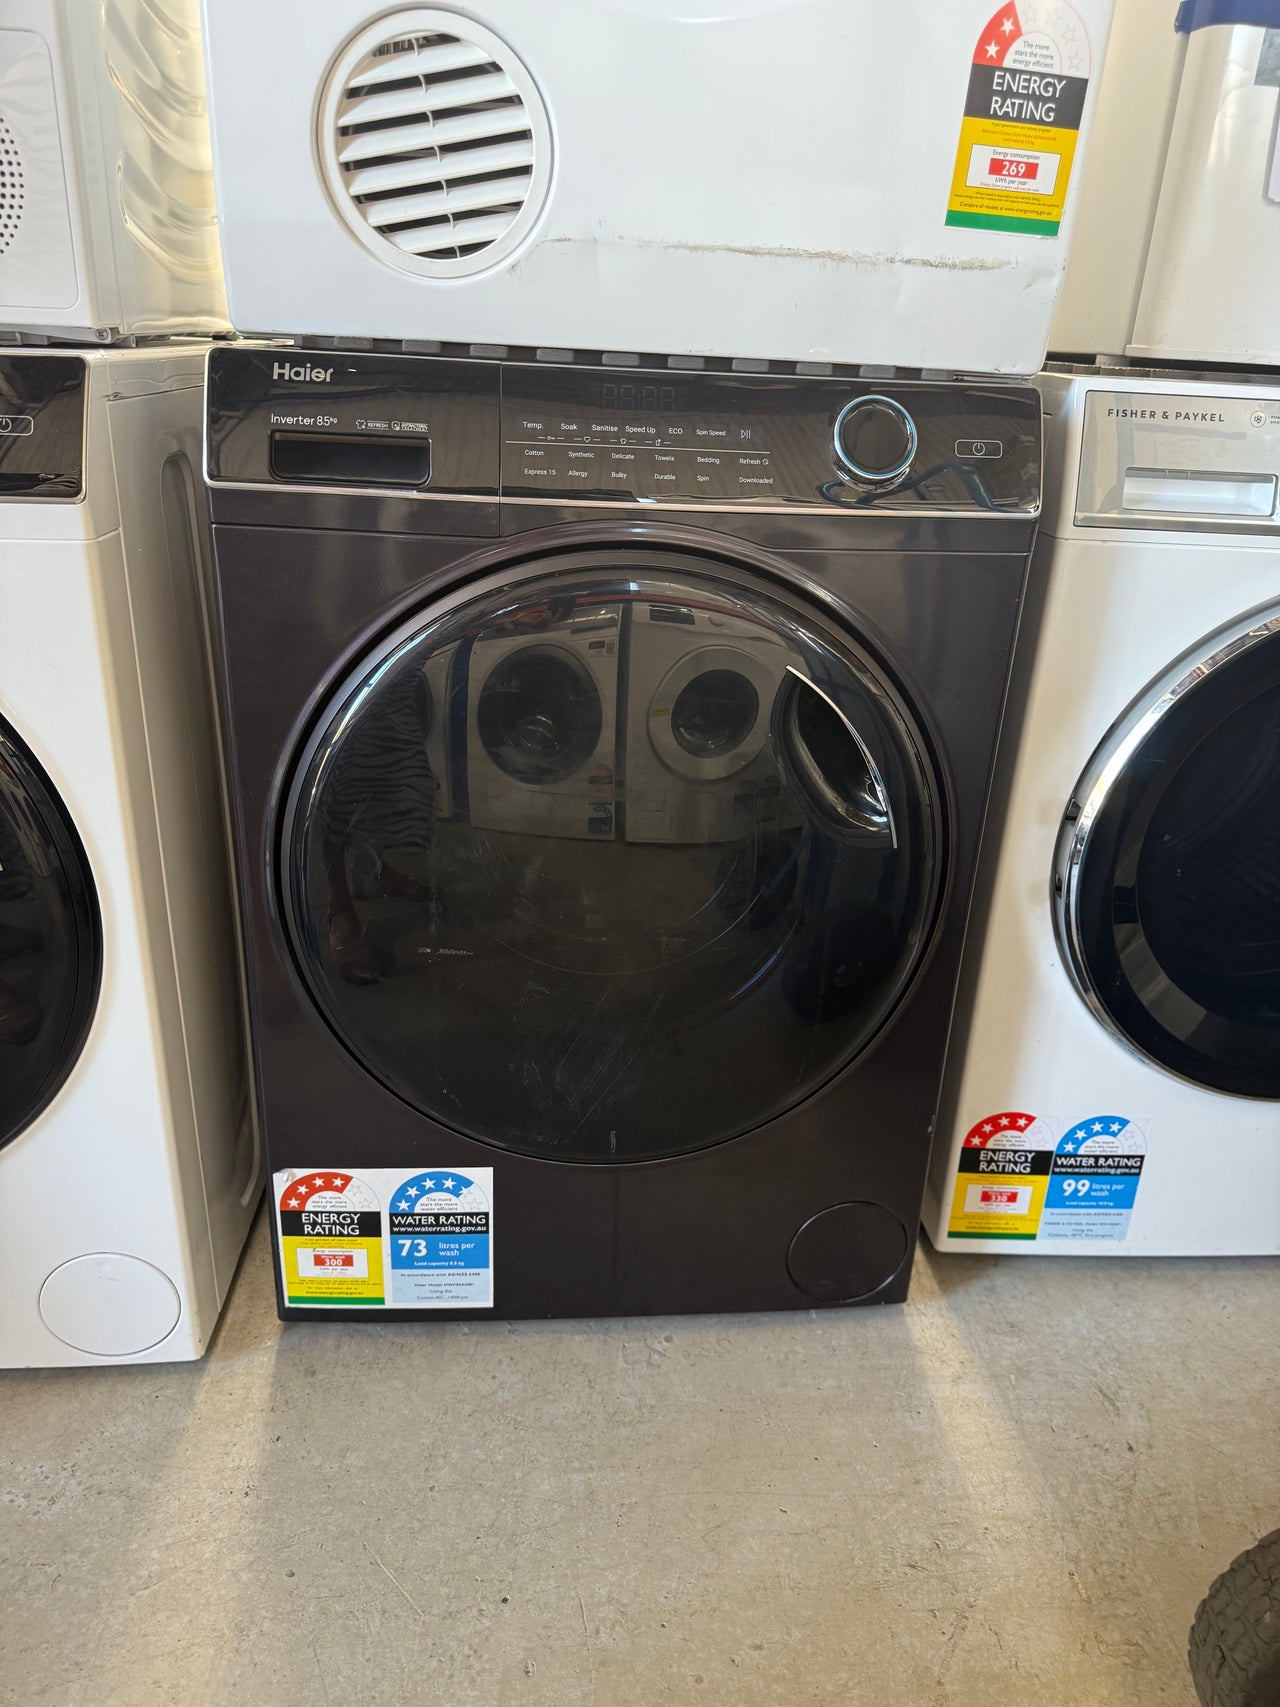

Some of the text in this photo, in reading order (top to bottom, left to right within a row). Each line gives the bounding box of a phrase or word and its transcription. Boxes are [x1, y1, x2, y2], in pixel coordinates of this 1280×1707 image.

[1012, 58, 1054, 69] energy efficient
[992, 71, 1066, 98] ENERGY
[990, 96, 1056, 122] RATING
[992, 149, 1040, 160] Energy consumption
[1001, 161, 1026, 176] 269
[1008, 178, 1016, 186] per
[272, 362, 333, 382] Haier
[271, 413, 315, 425] Inverter
[1108, 408, 1224, 422] FISHER & PAYKEL
[523, 421, 544, 429] Temp.
[560, 423, 578, 431] Soak
[592, 424, 618, 432] Sanitise
[625, 425, 645, 434] Speed
[739, 476, 773, 484] Downloaded
[980, 1150, 1035, 1162] ENERGY
[1056, 1157, 1141, 1166] WATER RATING
[979, 1162, 1031, 1173] RATING
[1063, 1179, 1090, 1196] 99
[302, 1213, 360, 1224] ENERGY
[393, 1215, 486, 1225] WATER RATING
[304, 1225, 360, 1235] RATING
[398, 1239, 427, 1256] 73
